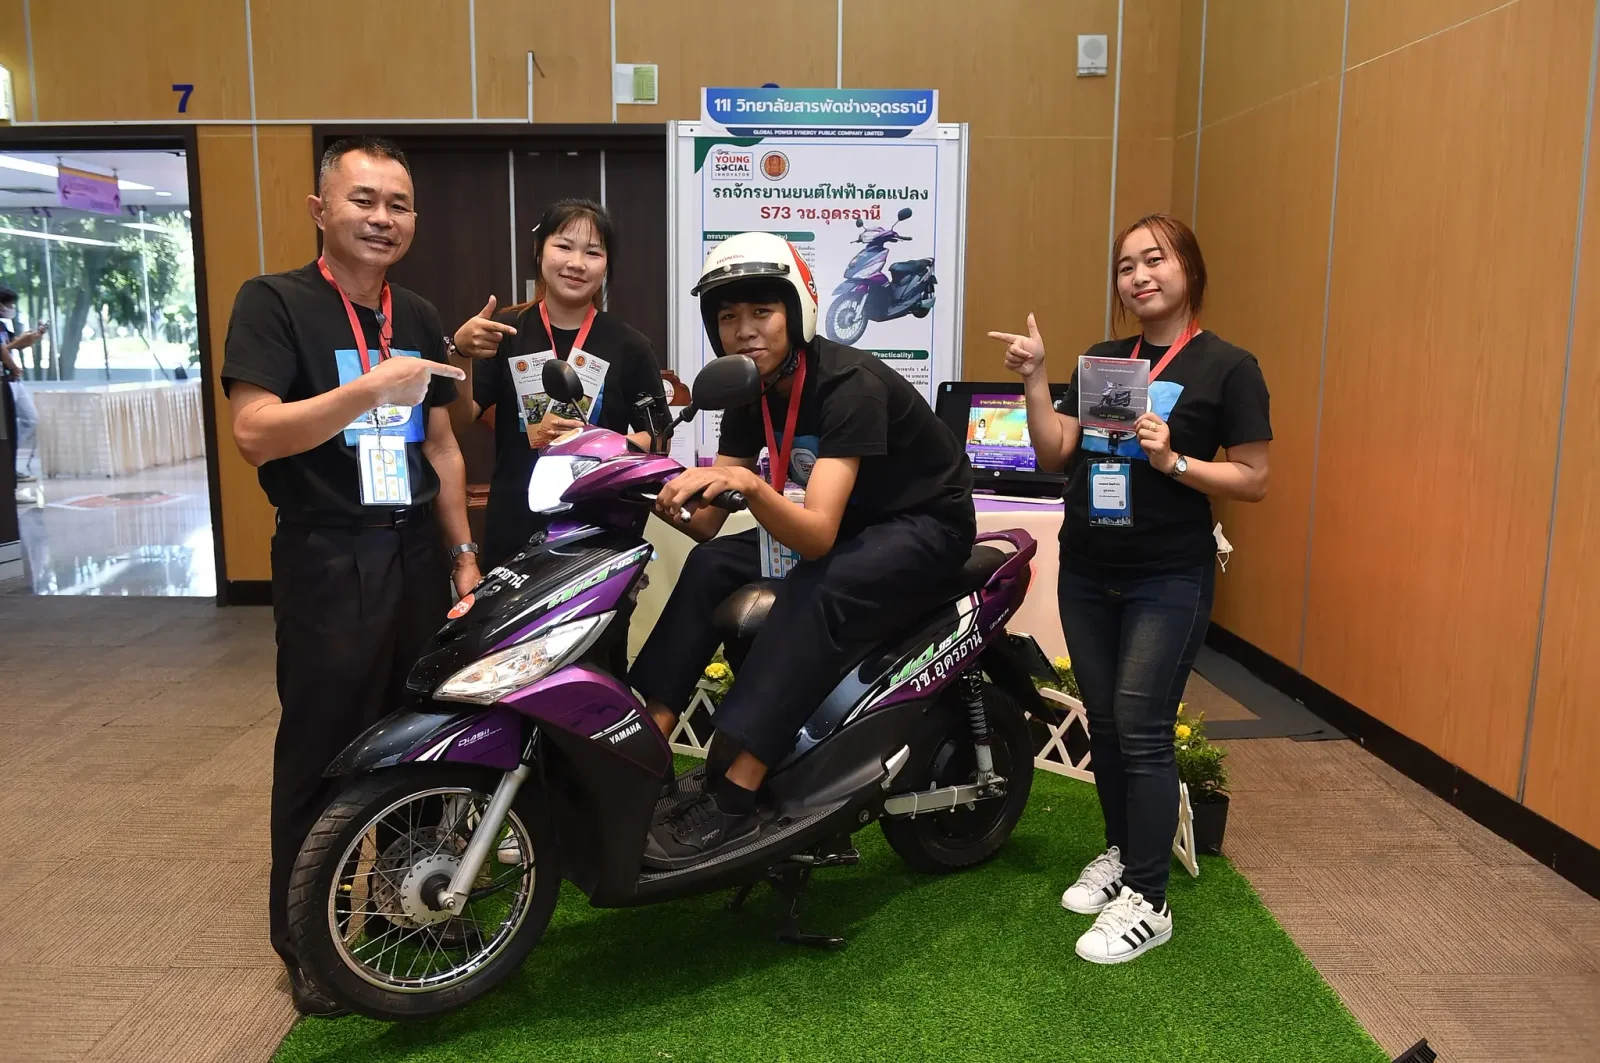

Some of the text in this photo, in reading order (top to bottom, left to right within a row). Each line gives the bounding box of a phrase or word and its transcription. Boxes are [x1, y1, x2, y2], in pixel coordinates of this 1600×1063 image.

[172, 84, 194, 113] 7
[736, 97, 927, 118] วิทยาลัยสารพัดช่างอุดรธานี
[713, 183, 928, 200] รถจักรยานยนต์ไฟฟ้าดัดแปลง
[761, 204, 881, 225] S73 วช.อุดรธานี
[716, 254, 744, 265] HONDA
[910, 623, 983, 692] วช.อุดรธานี
[609, 721, 642, 744] YAMAHA
